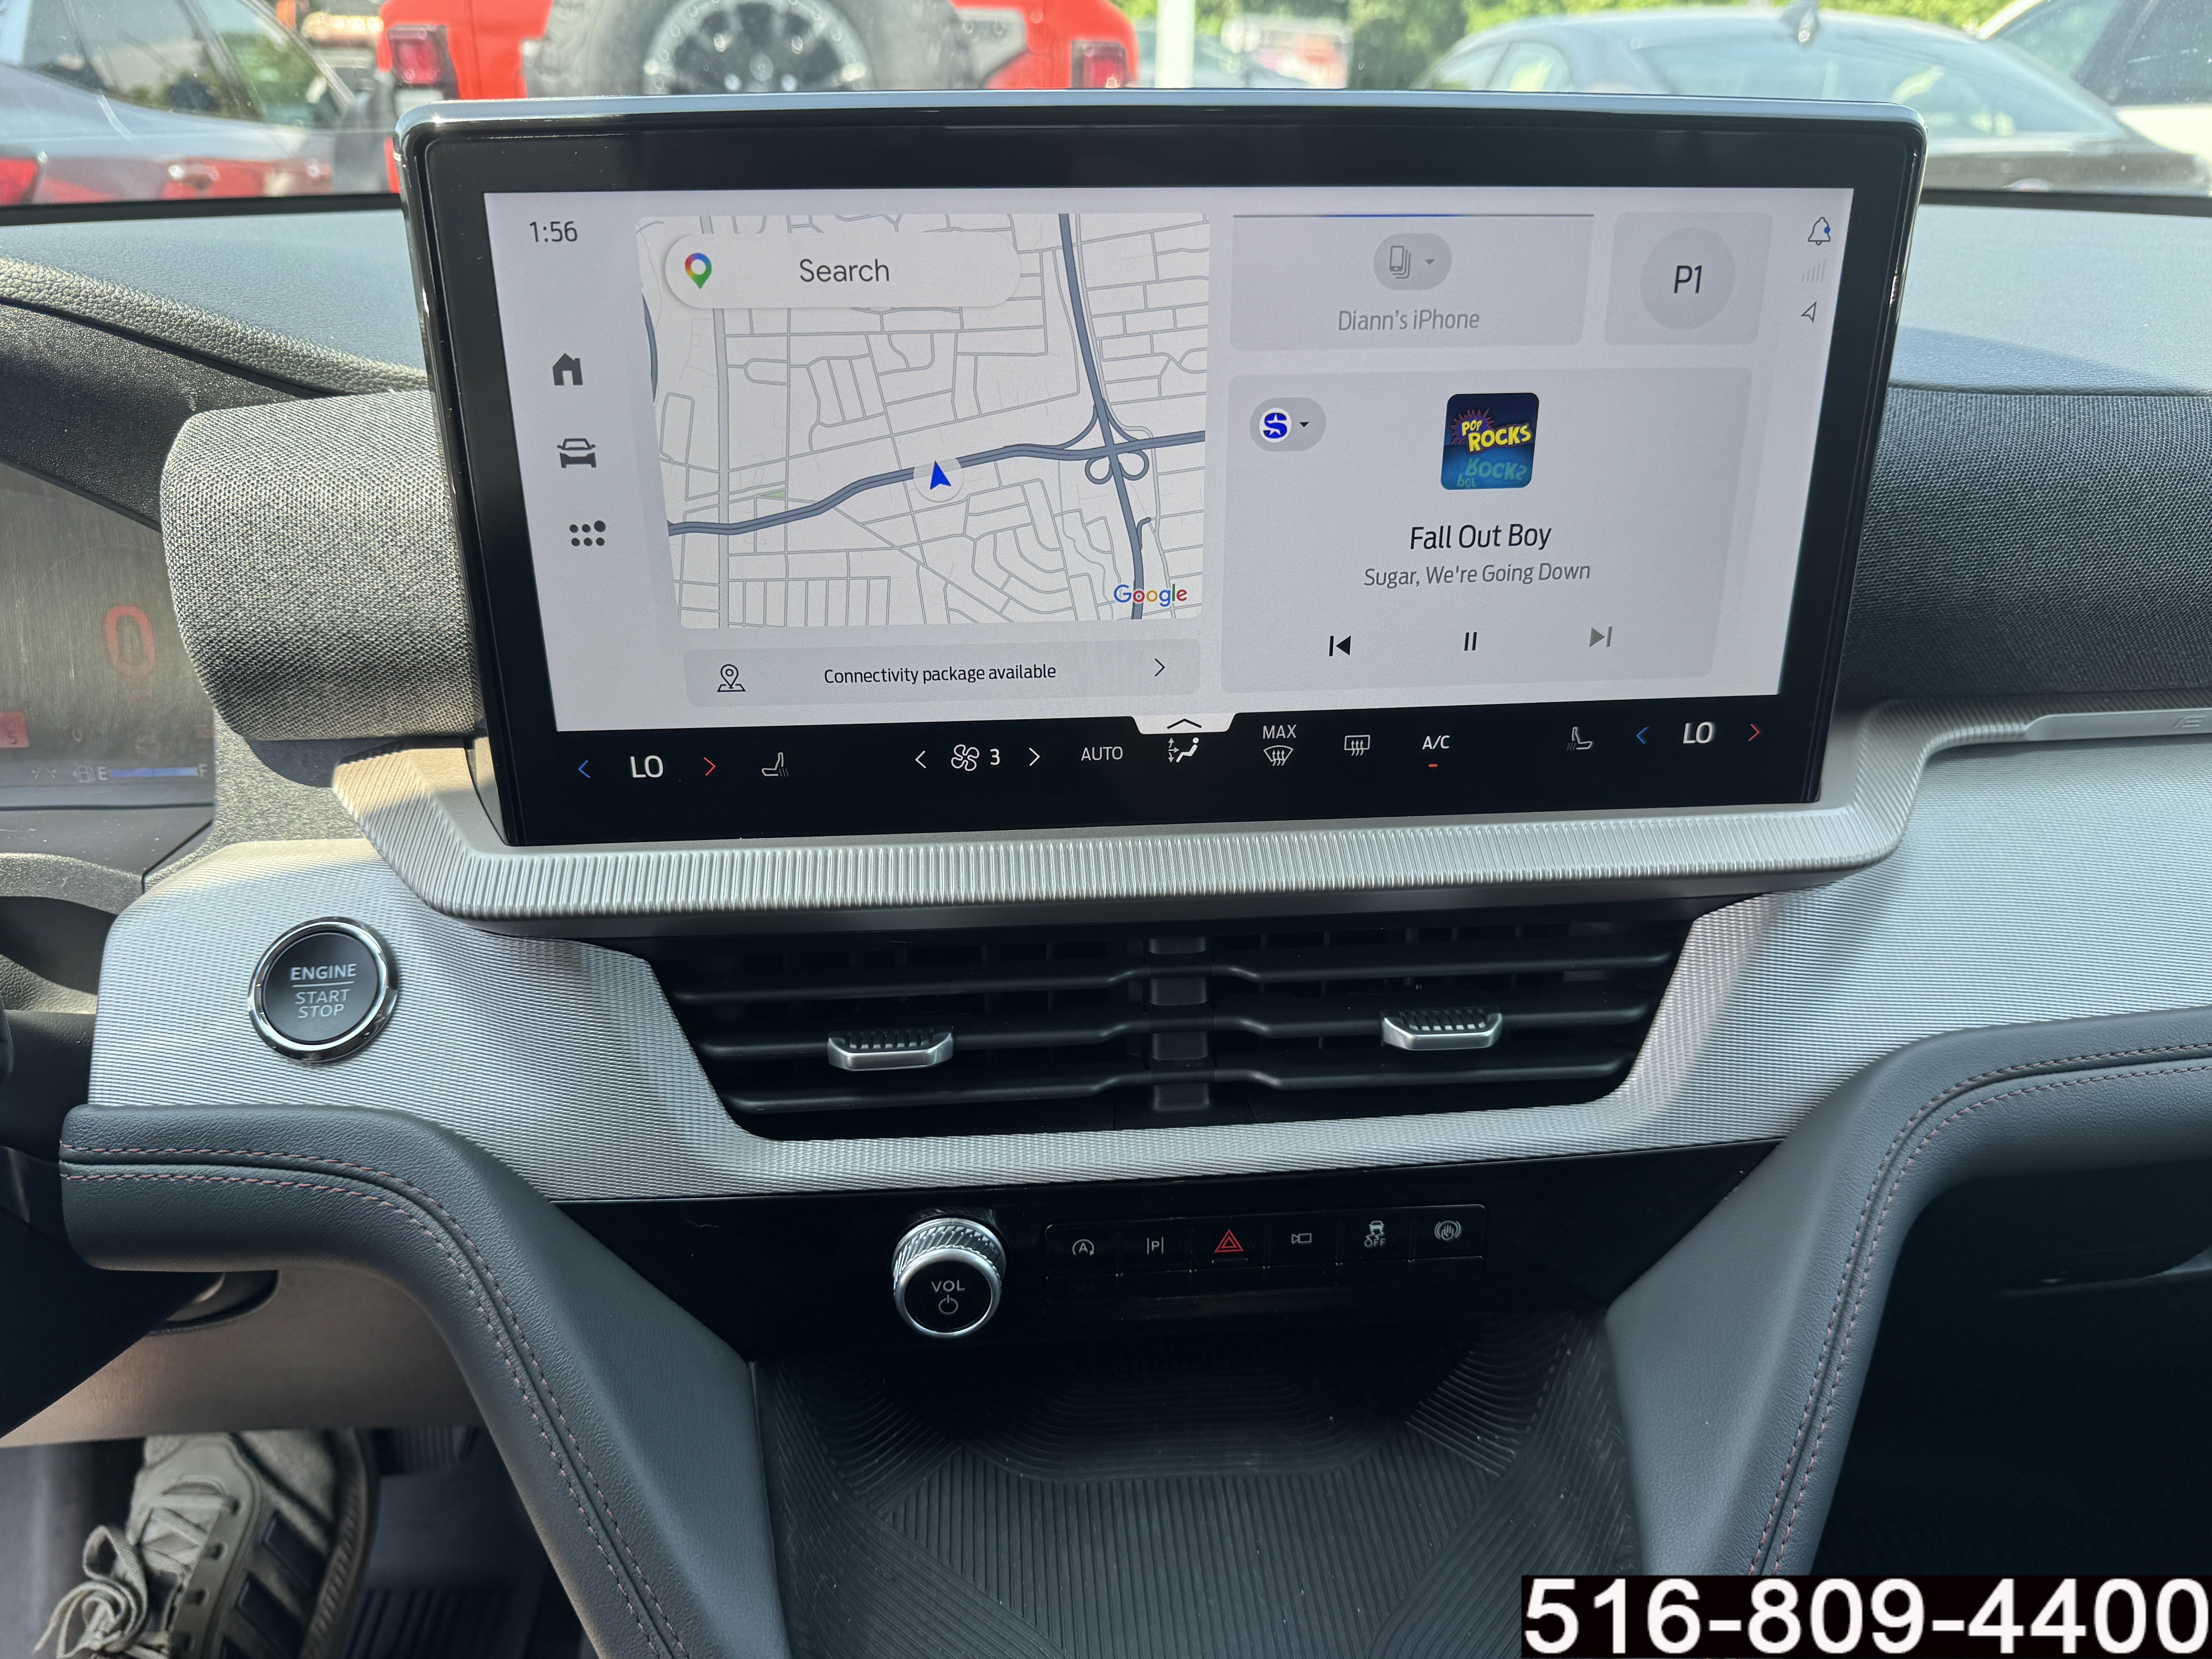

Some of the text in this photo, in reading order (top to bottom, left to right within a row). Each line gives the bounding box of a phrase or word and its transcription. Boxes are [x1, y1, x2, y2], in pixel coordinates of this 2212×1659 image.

[529, 221, 578, 242] 1:56
[800, 259, 890, 282] Search
[1674, 265, 1702, 294] P1
[1338, 309, 1480, 331] Diann's iPhone
[1461, 419, 1482, 436] POP
[1468, 425, 1532, 452] ROCKS
[1410, 524, 1552, 550] Fall Out Boy
[1364, 563, 1590, 589] Sugar, We're Going Down
[1113, 584, 1188, 607] Google
[824, 664, 1056, 685] Connectivity package available
[1263, 724, 1297, 739] MAX
[1683, 721, 1714, 744] LO
[1422, 735, 1450, 750] A/C
[990, 749, 1000, 765] 3
[1081, 746, 1123, 761] AUTO
[98, 766, 109, 781] E
[630, 755, 663, 778] LO
[290, 963, 357, 981] ENGINE
[295, 988, 351, 1005] START
[297, 1003, 345, 1018] STOP
[1364, 1238, 1386, 1248] OFF
[931, 1279, 965, 1292] VOL
